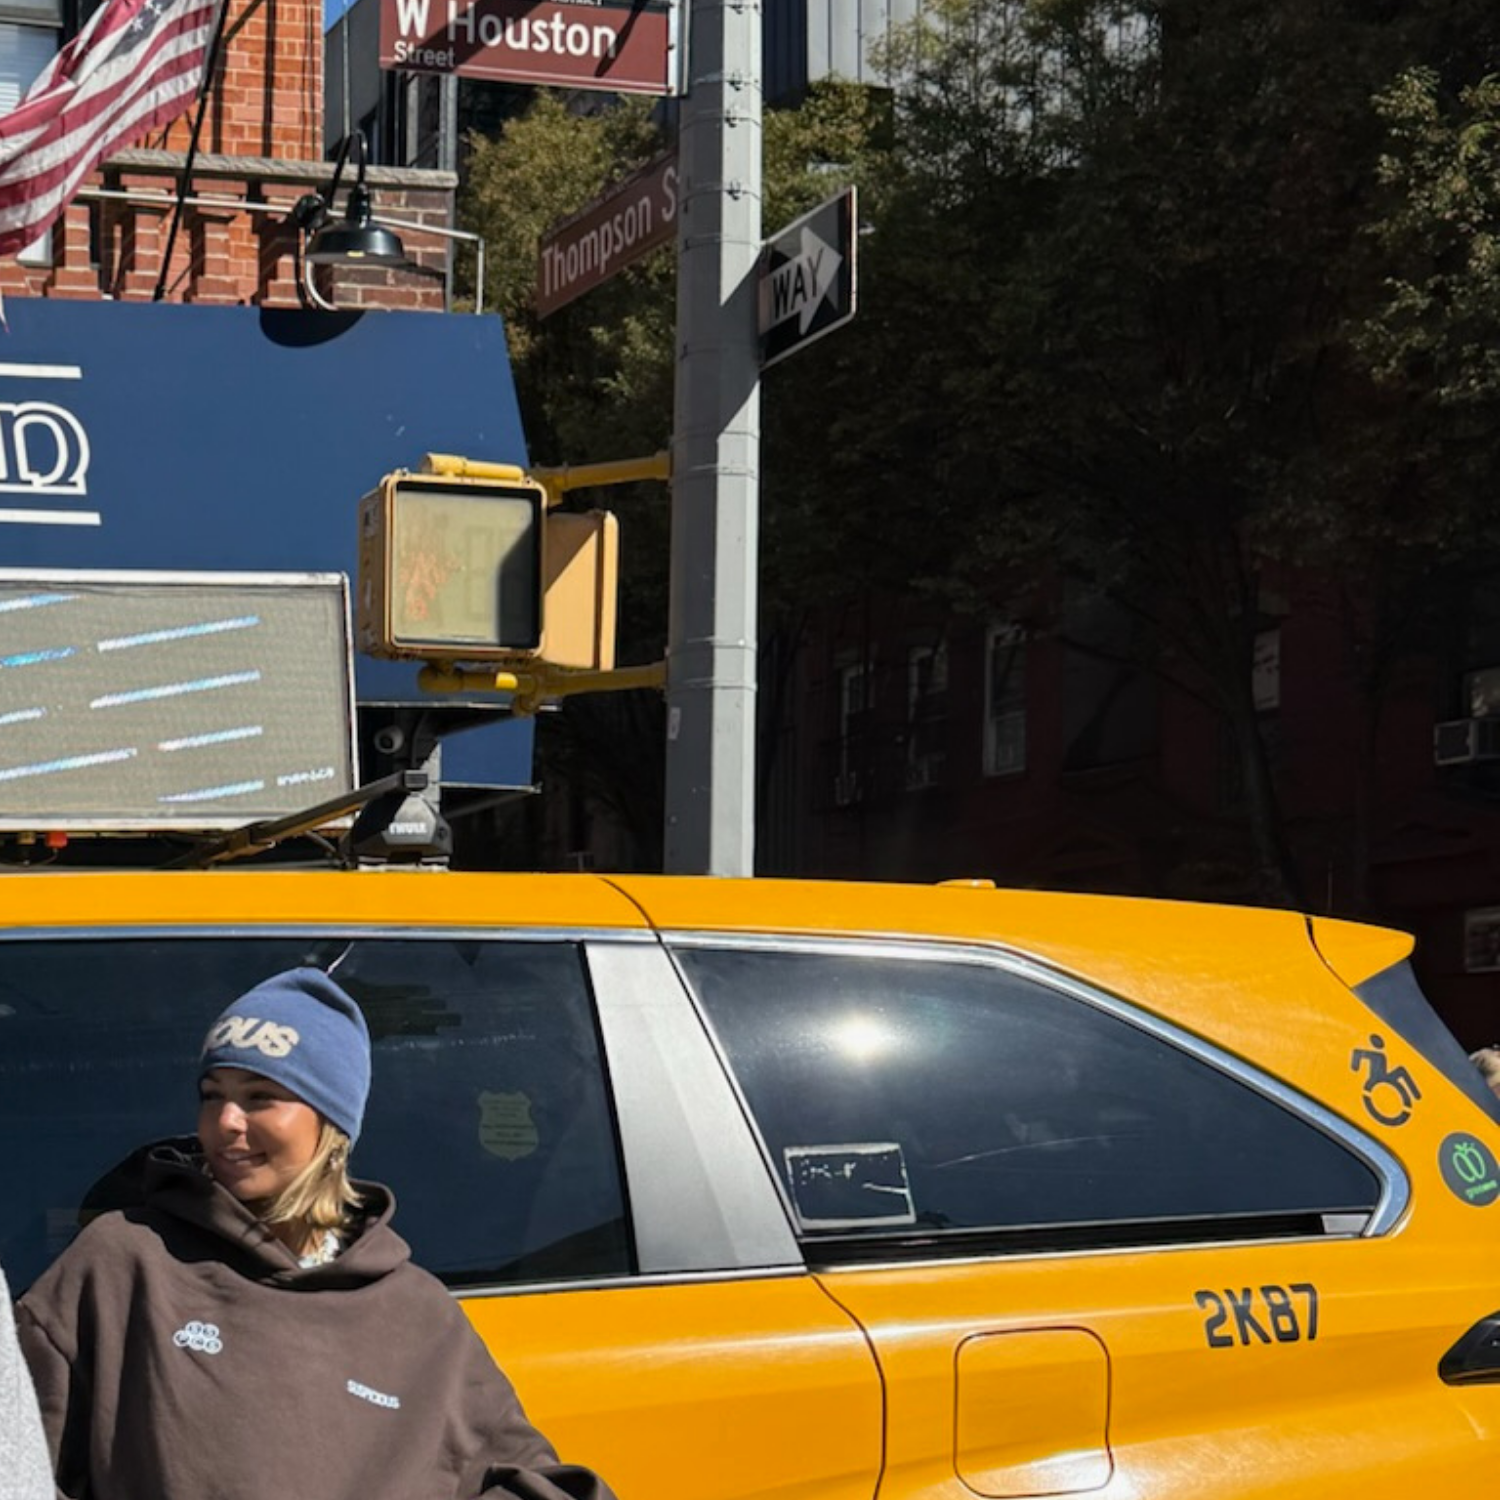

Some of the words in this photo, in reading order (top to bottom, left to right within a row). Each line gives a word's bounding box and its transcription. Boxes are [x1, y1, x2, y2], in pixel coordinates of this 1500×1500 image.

[393, 40, 456, 68] Street
[394, 0, 430, 39] W
[448, 1, 617, 58] Houston
[541, 195, 652, 297] Thompson
[661, 165, 680, 222] S
[772, 246, 825, 320] WAY
[1194, 1282, 1318, 1348] 2K87
